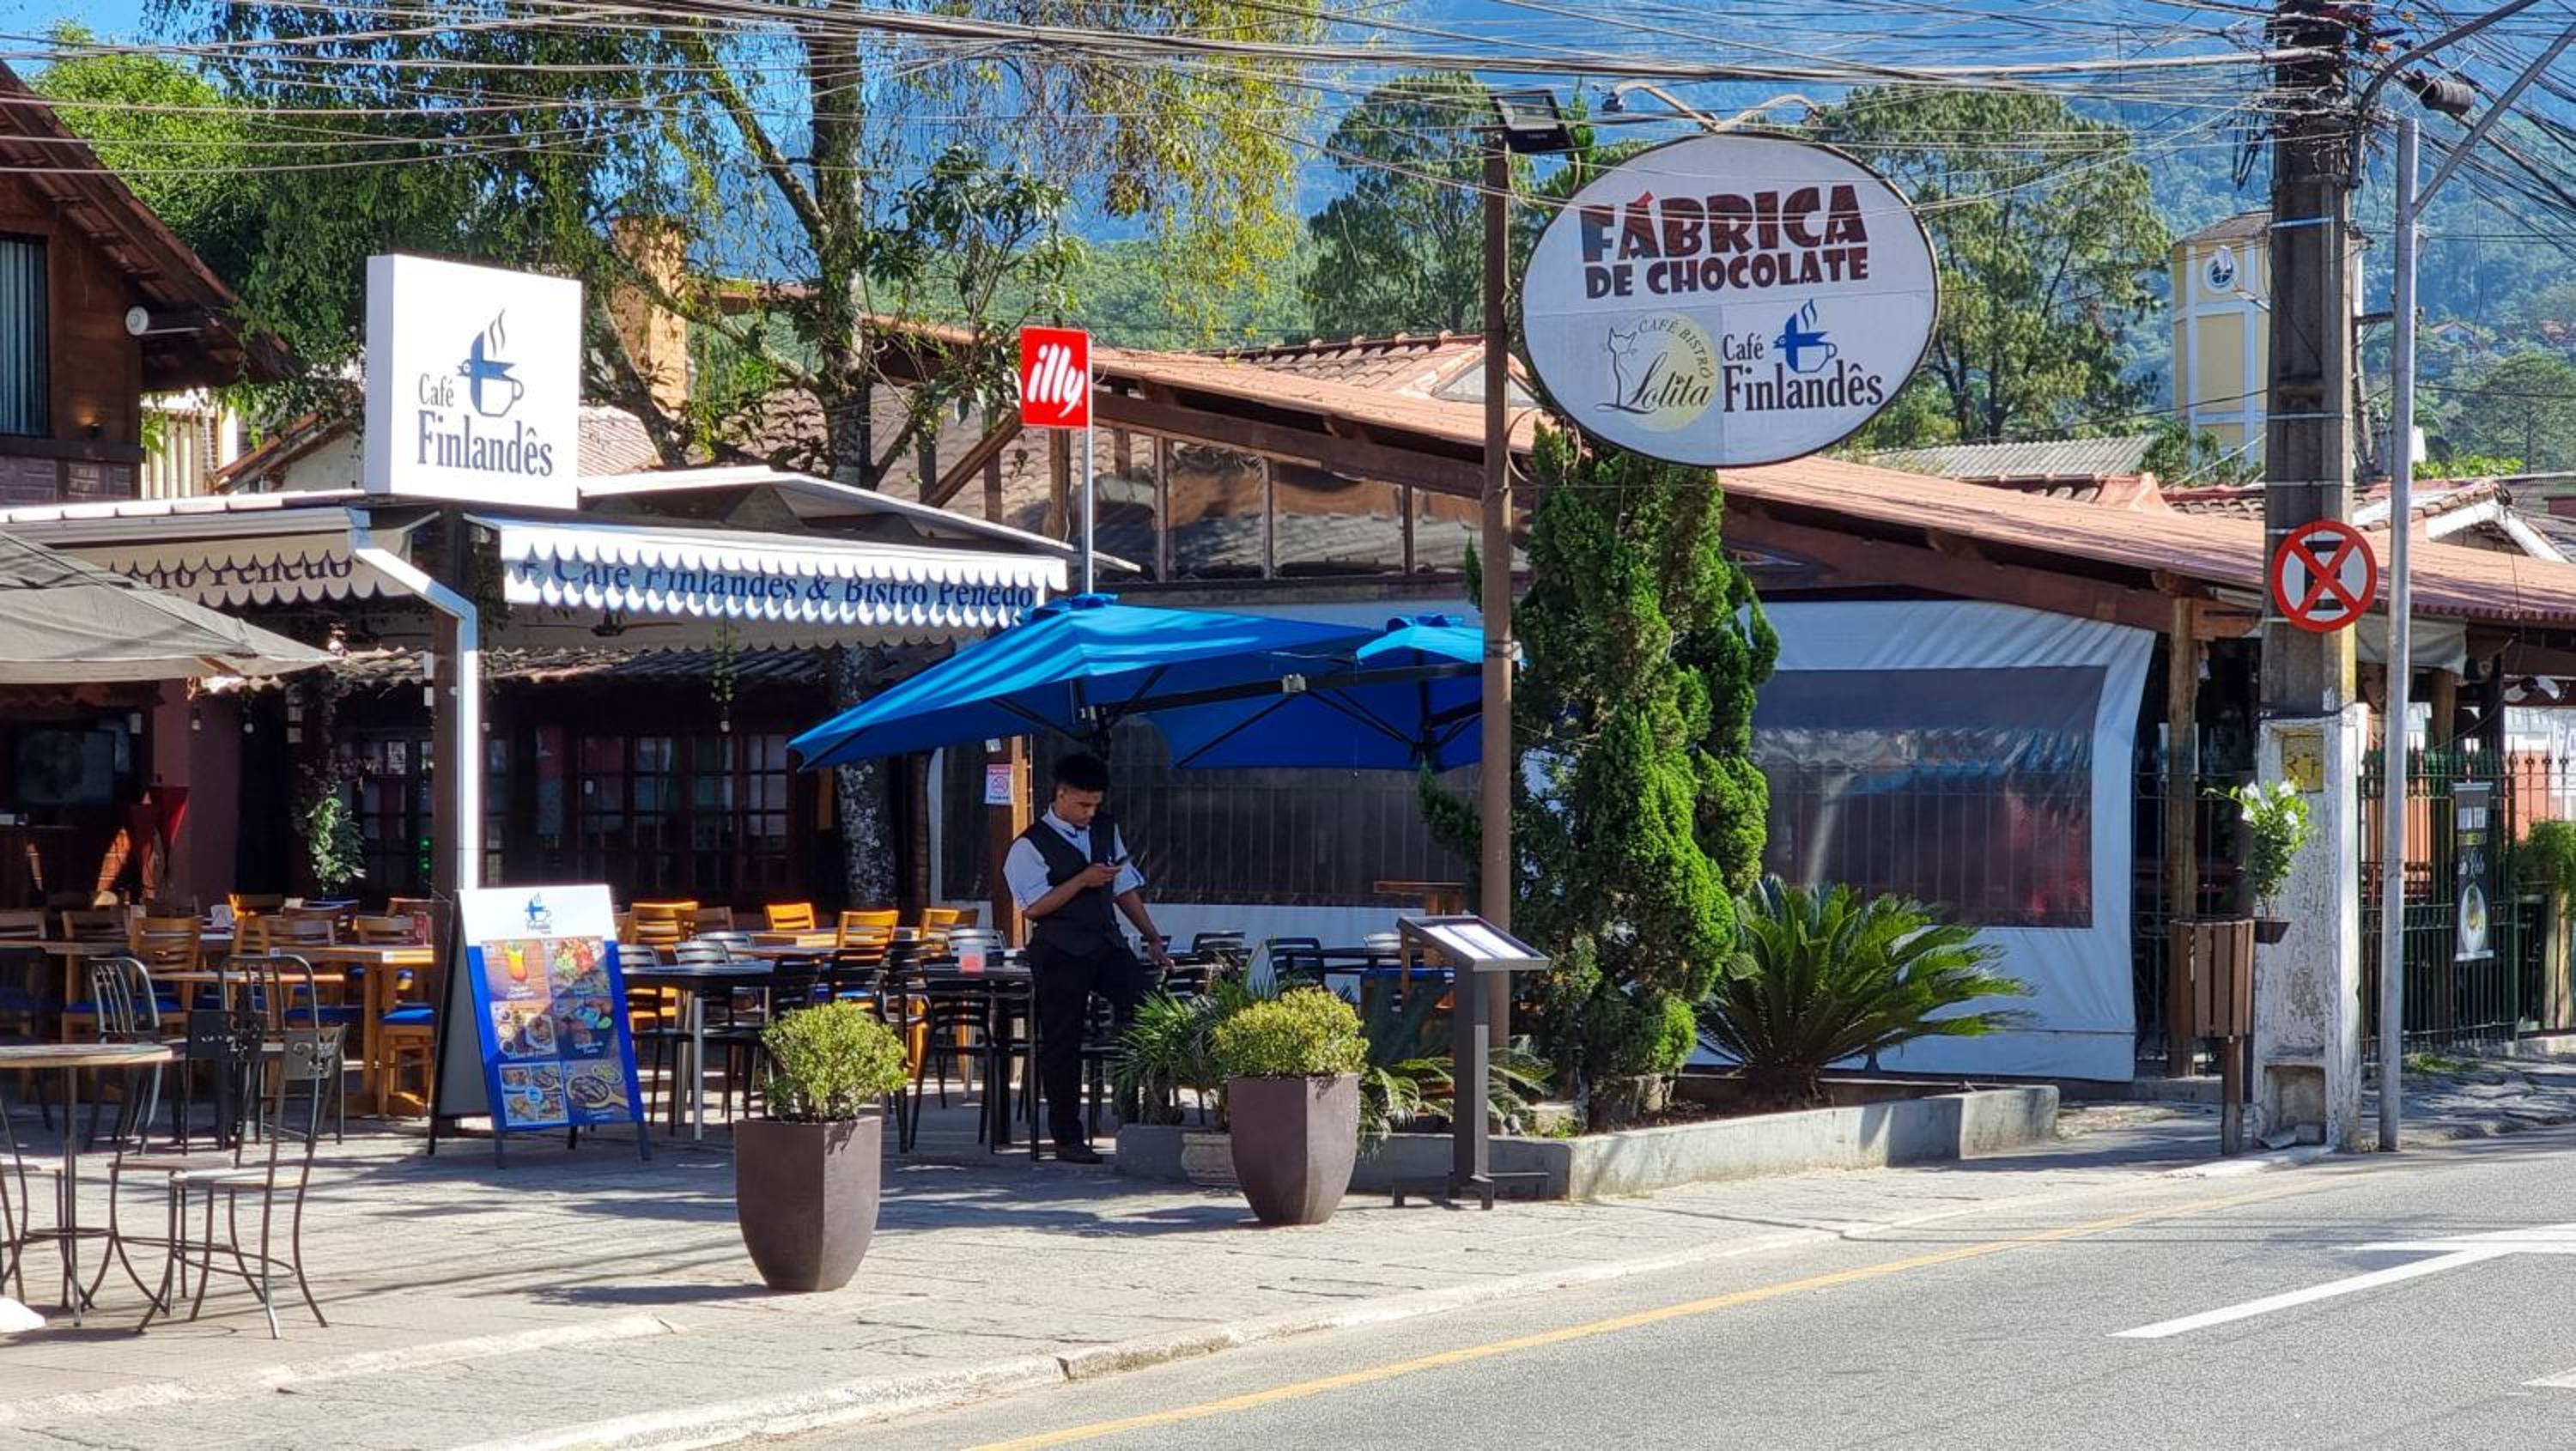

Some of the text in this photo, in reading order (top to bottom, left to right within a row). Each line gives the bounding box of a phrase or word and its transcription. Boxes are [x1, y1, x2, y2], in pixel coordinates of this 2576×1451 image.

[1579, 184, 1868, 264] FÁBRICA
[1585, 246, 1868, 300] DE CHOCOLATE
[1638, 318, 1679, 335] CAFÉ
[1722, 332, 1765, 361] Café
[418, 372, 454, 408] Café
[1027, 343, 1085, 419] illy
[1606, 352, 1710, 414] Lolita
[1722, 359, 1884, 413] Finlandês
[417, 409, 554, 477] Finlandês
[805, 574, 831, 602] &
[938, 580, 1034, 608] Penedo
